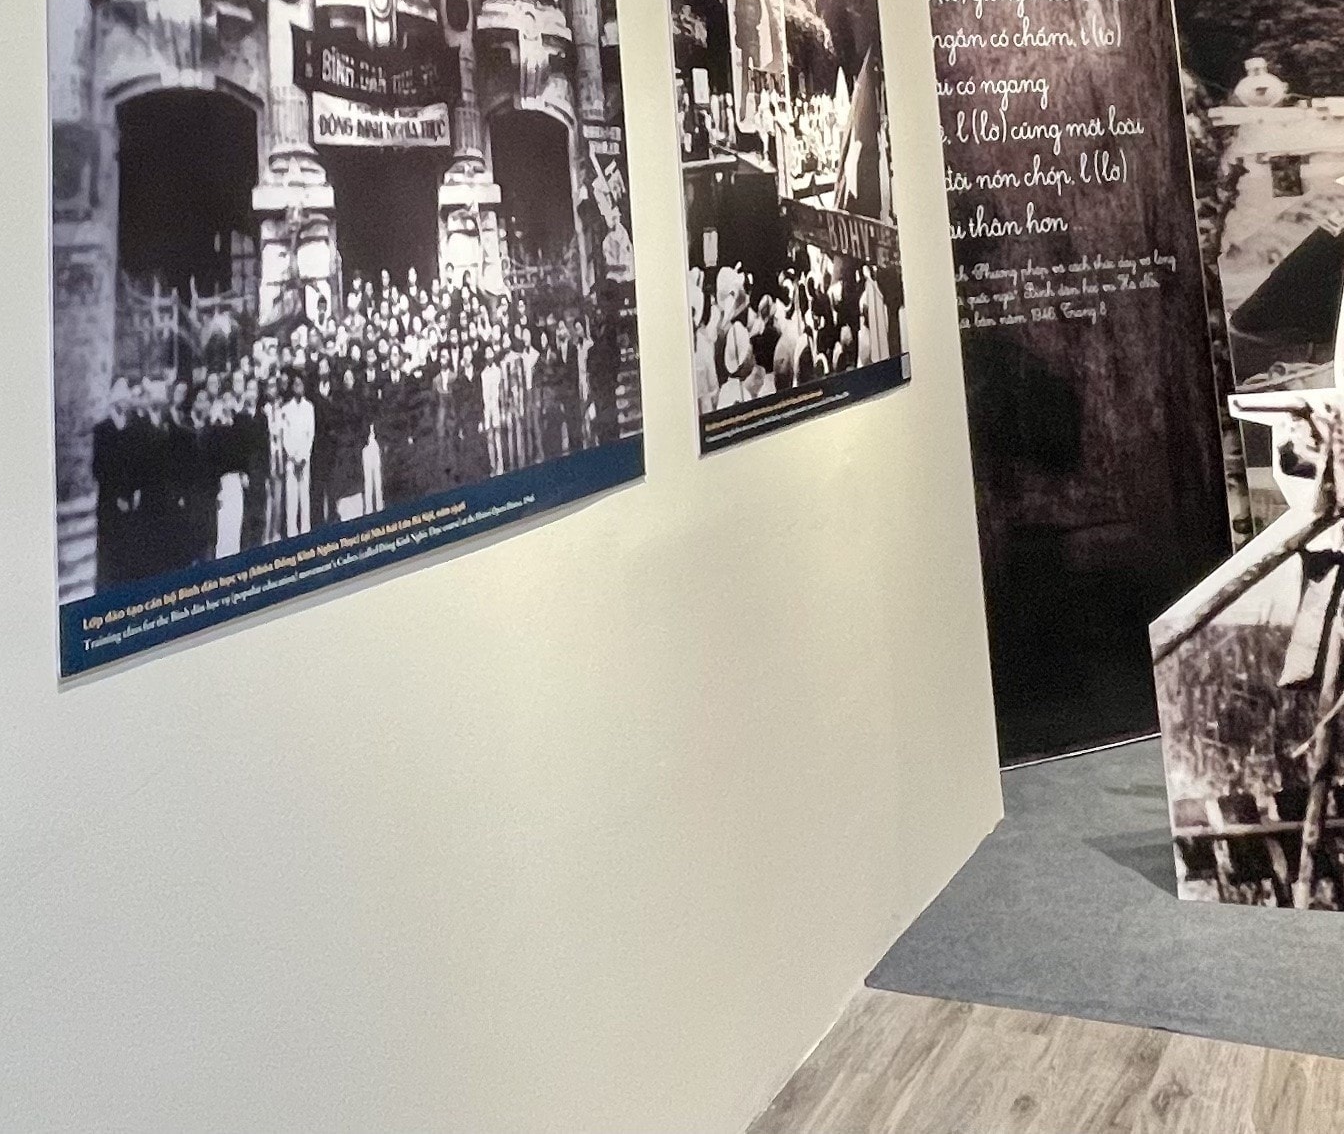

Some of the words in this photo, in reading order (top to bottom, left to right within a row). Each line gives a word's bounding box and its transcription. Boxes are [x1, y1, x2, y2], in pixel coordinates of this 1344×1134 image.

[990, 28, 1009, 47] có
[956, 77, 976, 96] có
[981, 78, 1049, 110] ngang
[1010, 122, 1062, 155] cũng
[1066, 118, 1105, 139] một
[1107, 104, 1145, 136] loài
[976, 170, 1020, 190] nón
[968, 205, 1023, 238] thân
[1026, 201, 1068, 234] hơn
